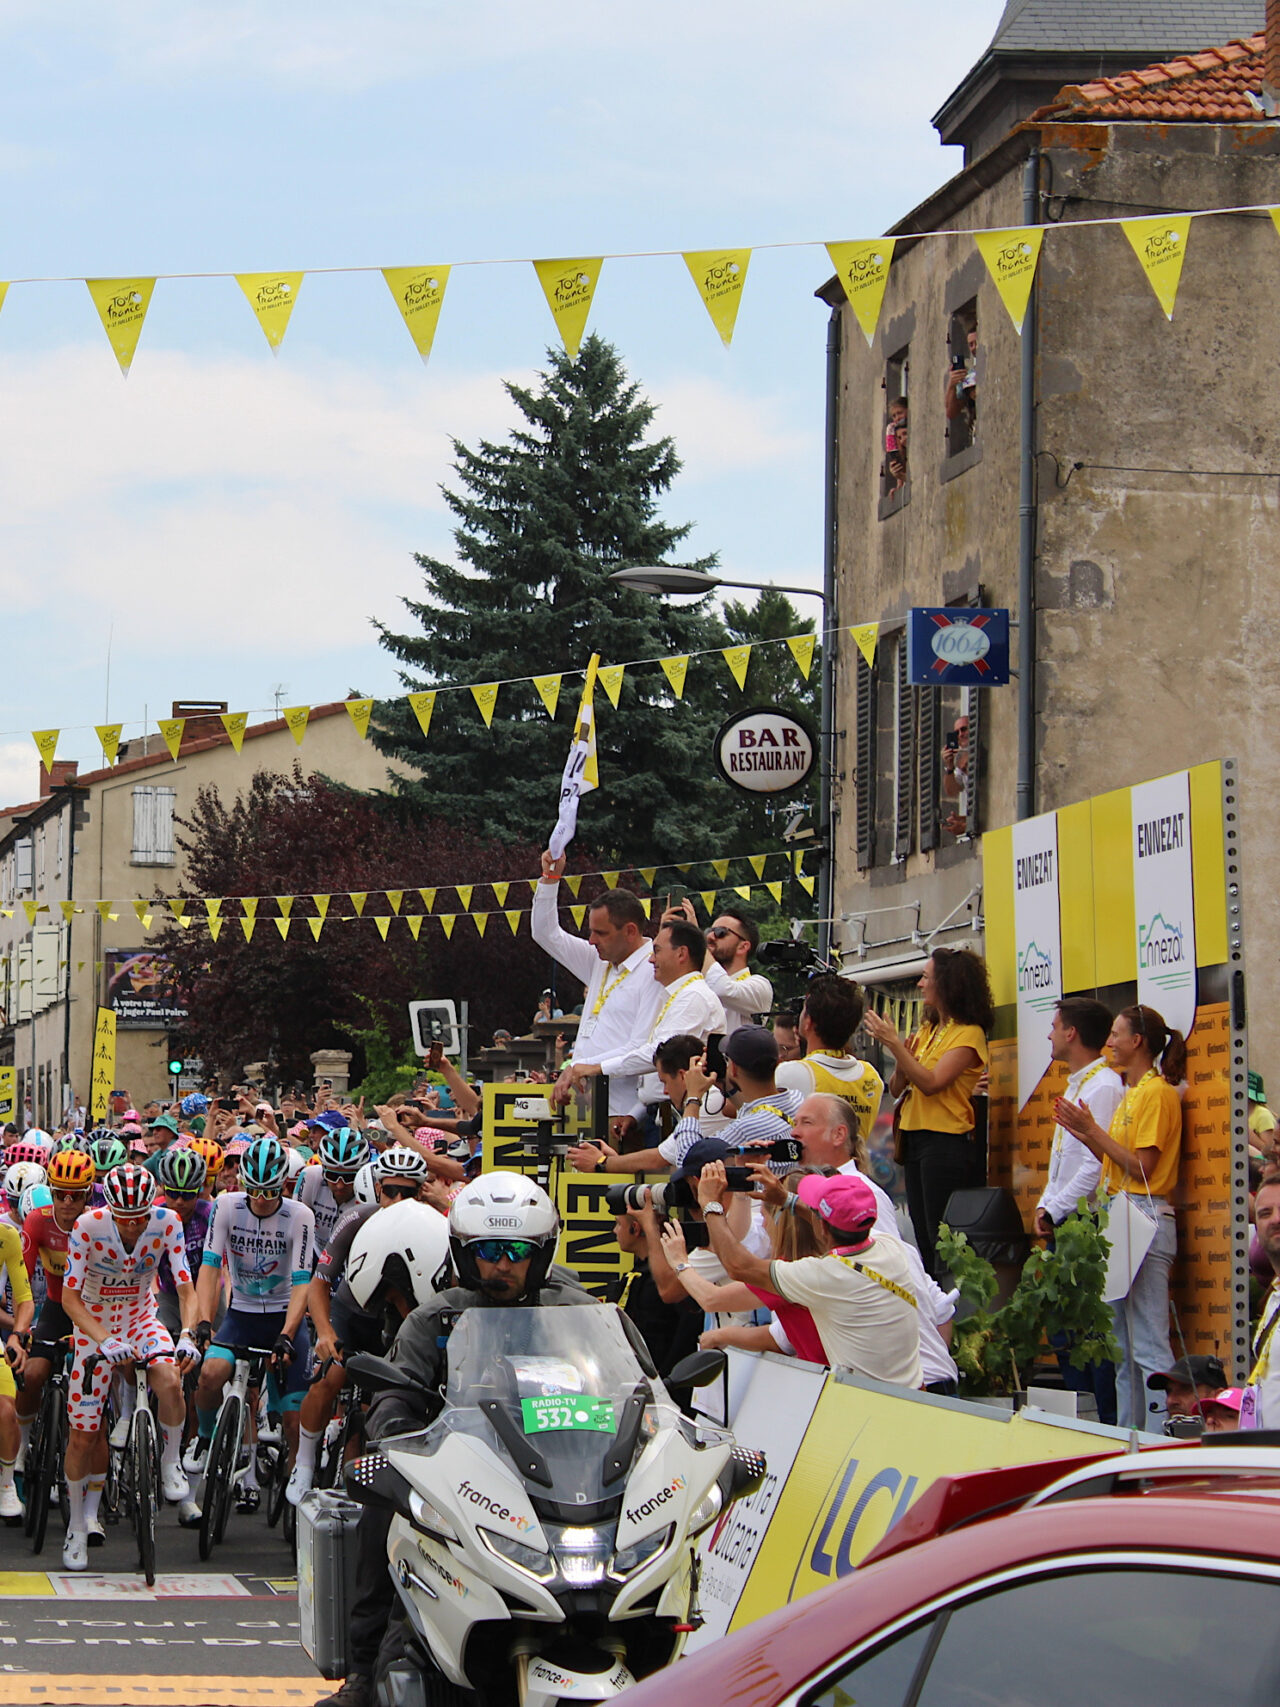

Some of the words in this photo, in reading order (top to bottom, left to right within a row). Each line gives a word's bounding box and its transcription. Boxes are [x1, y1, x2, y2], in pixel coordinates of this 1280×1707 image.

[935, 630, 987, 655] 1664
[739, 727, 801, 748] BAR
[729, 750, 806, 773] RESTAURANT
[1137, 812, 1185, 858] ENNEZAT
[1016, 850, 1053, 890] ENNEZAT
[1138, 922, 1185, 968] Ennezat
[1017, 949, 1053, 992] Ennezat
[123, 1007, 145, 1017] juger
[145, 1008, 164, 1016] Paul
[328, 1210, 360, 1244] deceuninck
[488, 1217, 518, 1228] SHOEI
[230, 1234, 288, 1249] BAHRAIN
[102, 1276, 141, 1287] UAE
[98, 1295, 138, 1303] XRG
[78, 1399, 101, 1408] Santini
[531, 1398, 577, 1408] RADIO-TV
[536, 1406, 574, 1429] 532
[575, 1492, 588, 1504] D
[33, 1618, 208, 1629] Tour
